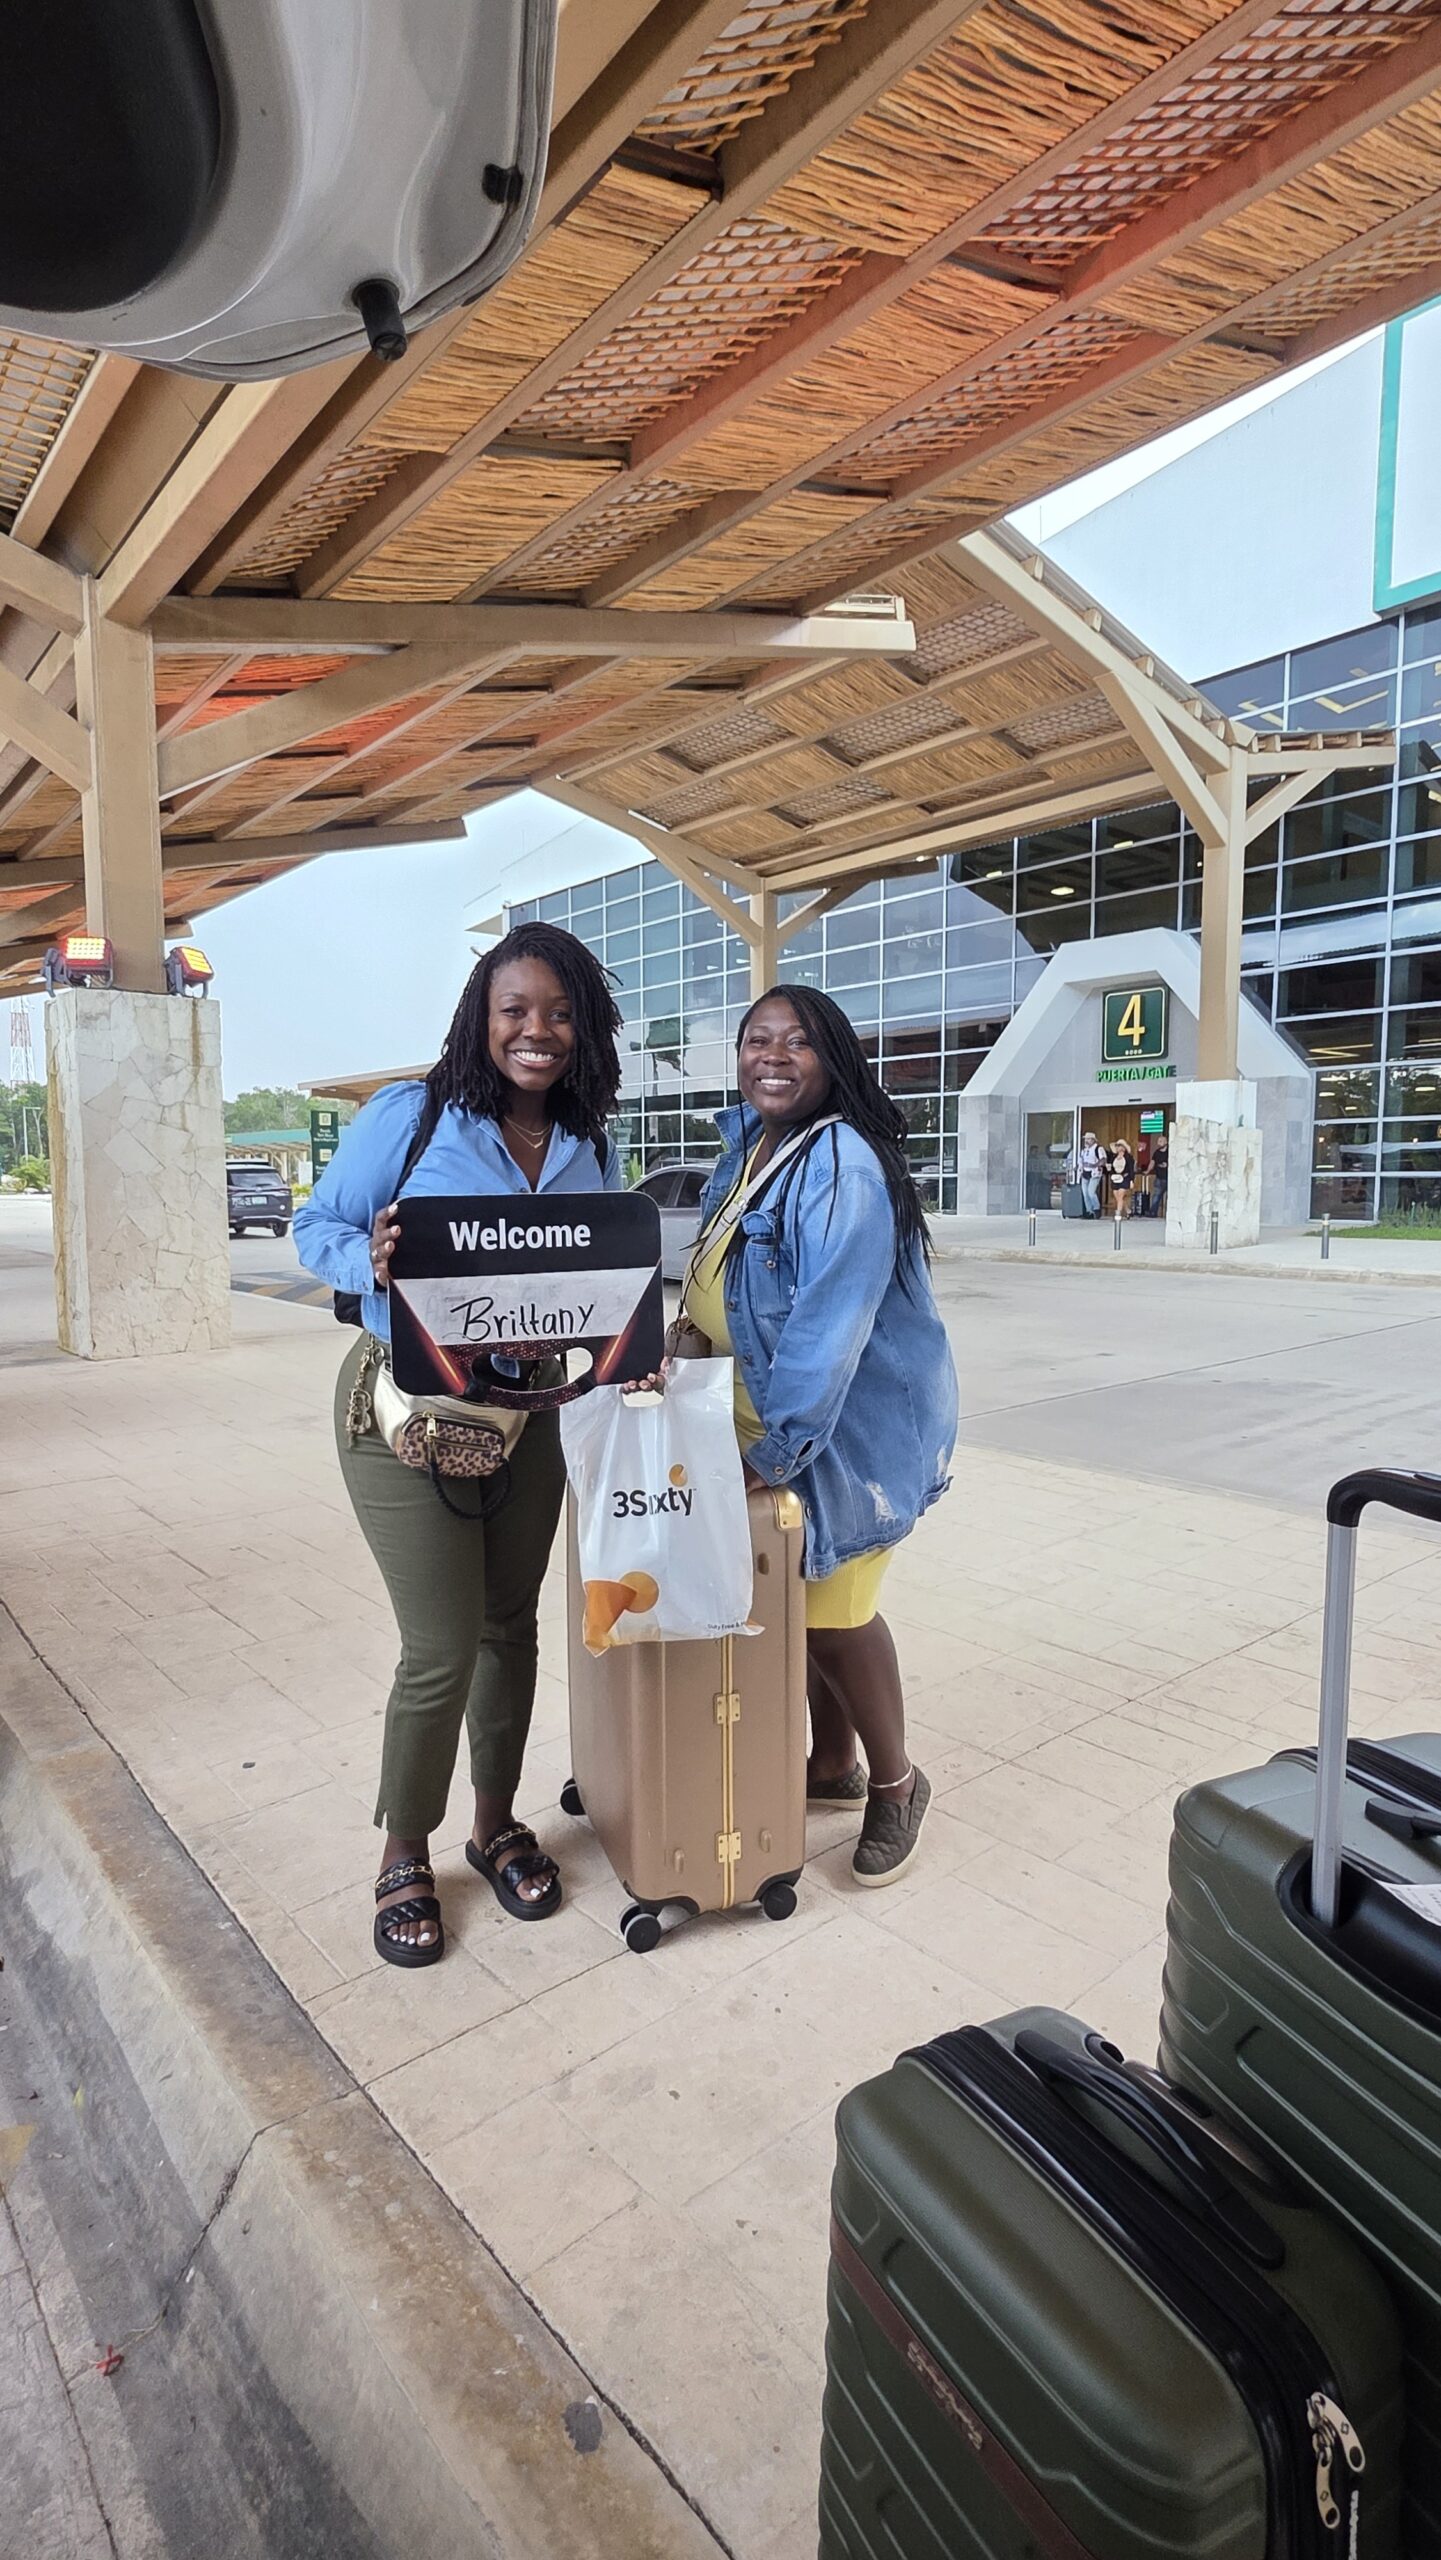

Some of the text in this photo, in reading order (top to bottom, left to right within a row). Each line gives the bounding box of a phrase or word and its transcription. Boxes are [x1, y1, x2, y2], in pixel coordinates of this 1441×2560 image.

[1117, 994, 1146, 1046] 4
[448, 1218, 591, 1251] Welcome
[450, 1297, 594, 1341] Brittany
[612, 1487, 693, 1518] 3Sixty
